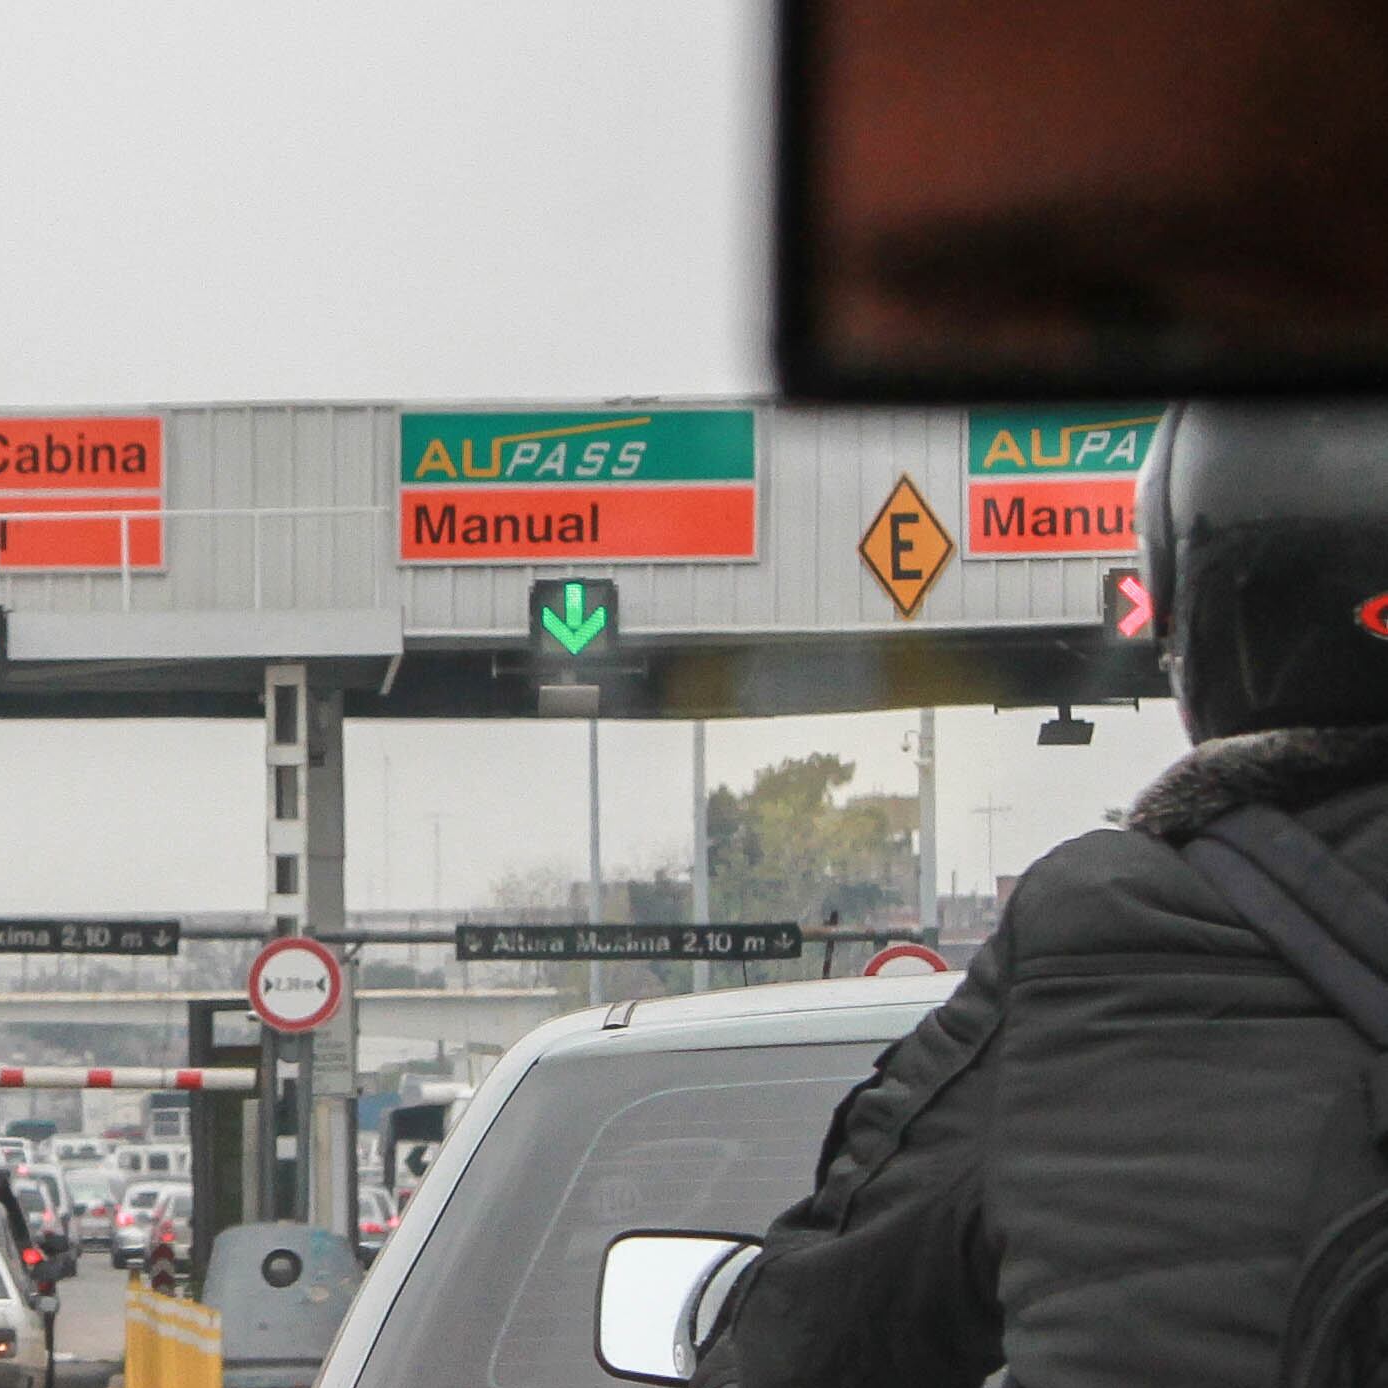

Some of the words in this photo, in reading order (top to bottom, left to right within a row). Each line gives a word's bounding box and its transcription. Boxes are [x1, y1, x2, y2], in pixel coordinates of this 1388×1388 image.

[415, 429, 649, 478] AUPASS
[414, 504, 600, 545] Manual
[890, 512, 923, 581] E
[742, 936, 767, 952] m
